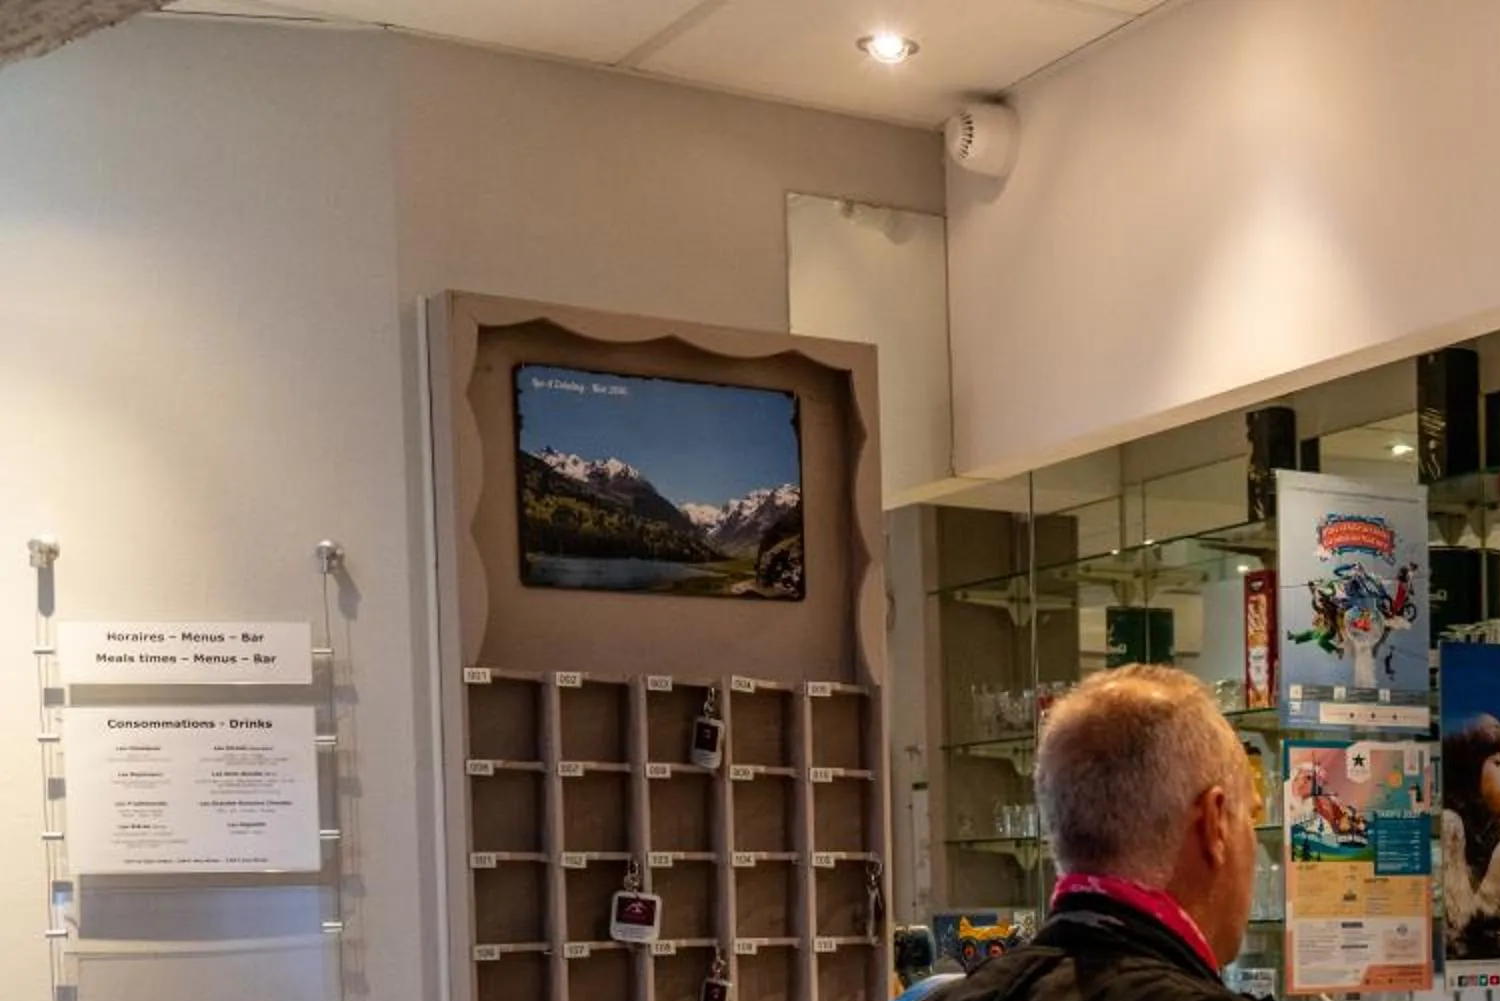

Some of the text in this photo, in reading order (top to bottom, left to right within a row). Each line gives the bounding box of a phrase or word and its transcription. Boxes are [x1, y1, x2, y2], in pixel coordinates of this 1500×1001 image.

[107, 631, 265, 643] Horaires Menus Bar
[96, 653, 277, 664] Meals times Menus Bar
[107, 719, 273, 730] Consommations Drinks
